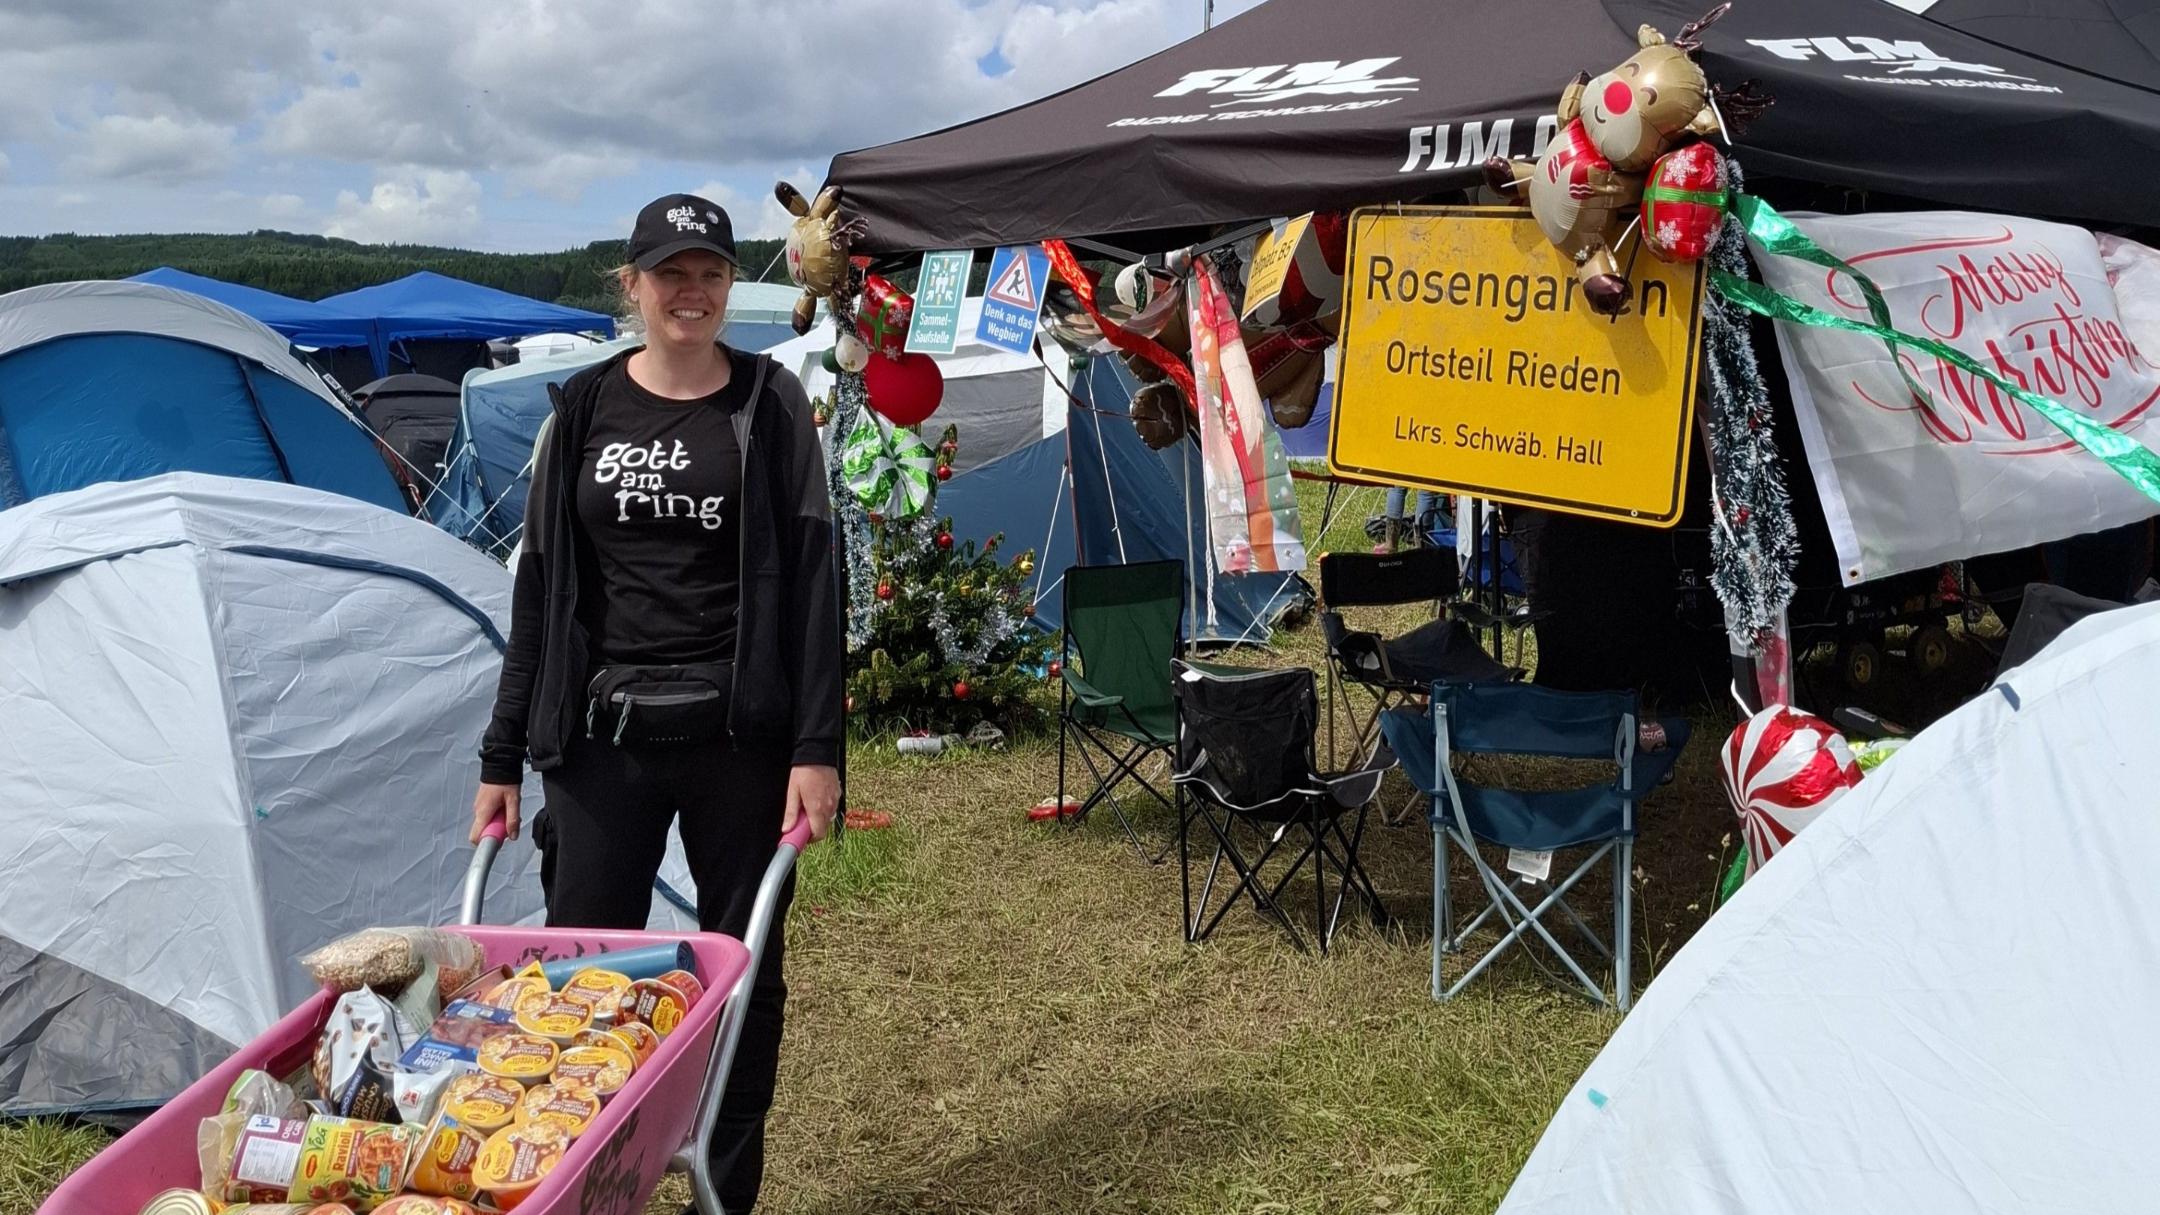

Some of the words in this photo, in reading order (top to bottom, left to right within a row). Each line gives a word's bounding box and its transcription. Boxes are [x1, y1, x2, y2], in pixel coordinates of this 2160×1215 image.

[1745, 36, 1950, 62] FLM
[1153, 56, 1402, 98] FLM
[1930, 78, 2064, 94] TECHNOLOGY
[1107, 113, 1209, 128] RACING
[1207, 97, 1403, 121] TECHNOLOGY
[667, 205, 697, 223] gott
[675, 221, 708, 235] ring
[1921, 240, 2082, 340] Merry
[918, 312, 952, 327] Sammel-
[984, 303, 1005, 321] Denk
[1005, 311, 1017, 325] an
[1017, 313, 1033, 331] das
[914, 329, 950, 345] Saufstelle
[986, 322, 1024, 345] Wegbier!
[1386, 340, 1494, 384] Ortsteil
[1506, 350, 1622, 396] Rieden
[1394, 415, 1448, 446] Lkrs.
[1454, 423, 1547, 460] Schwäb.
[1556, 435, 1604, 466] Hall
[594, 439, 692, 484] gott
[620, 470, 666, 490] am
[613, 482, 725, 531] ring
[332, 1131, 353, 1171] Ravioli
